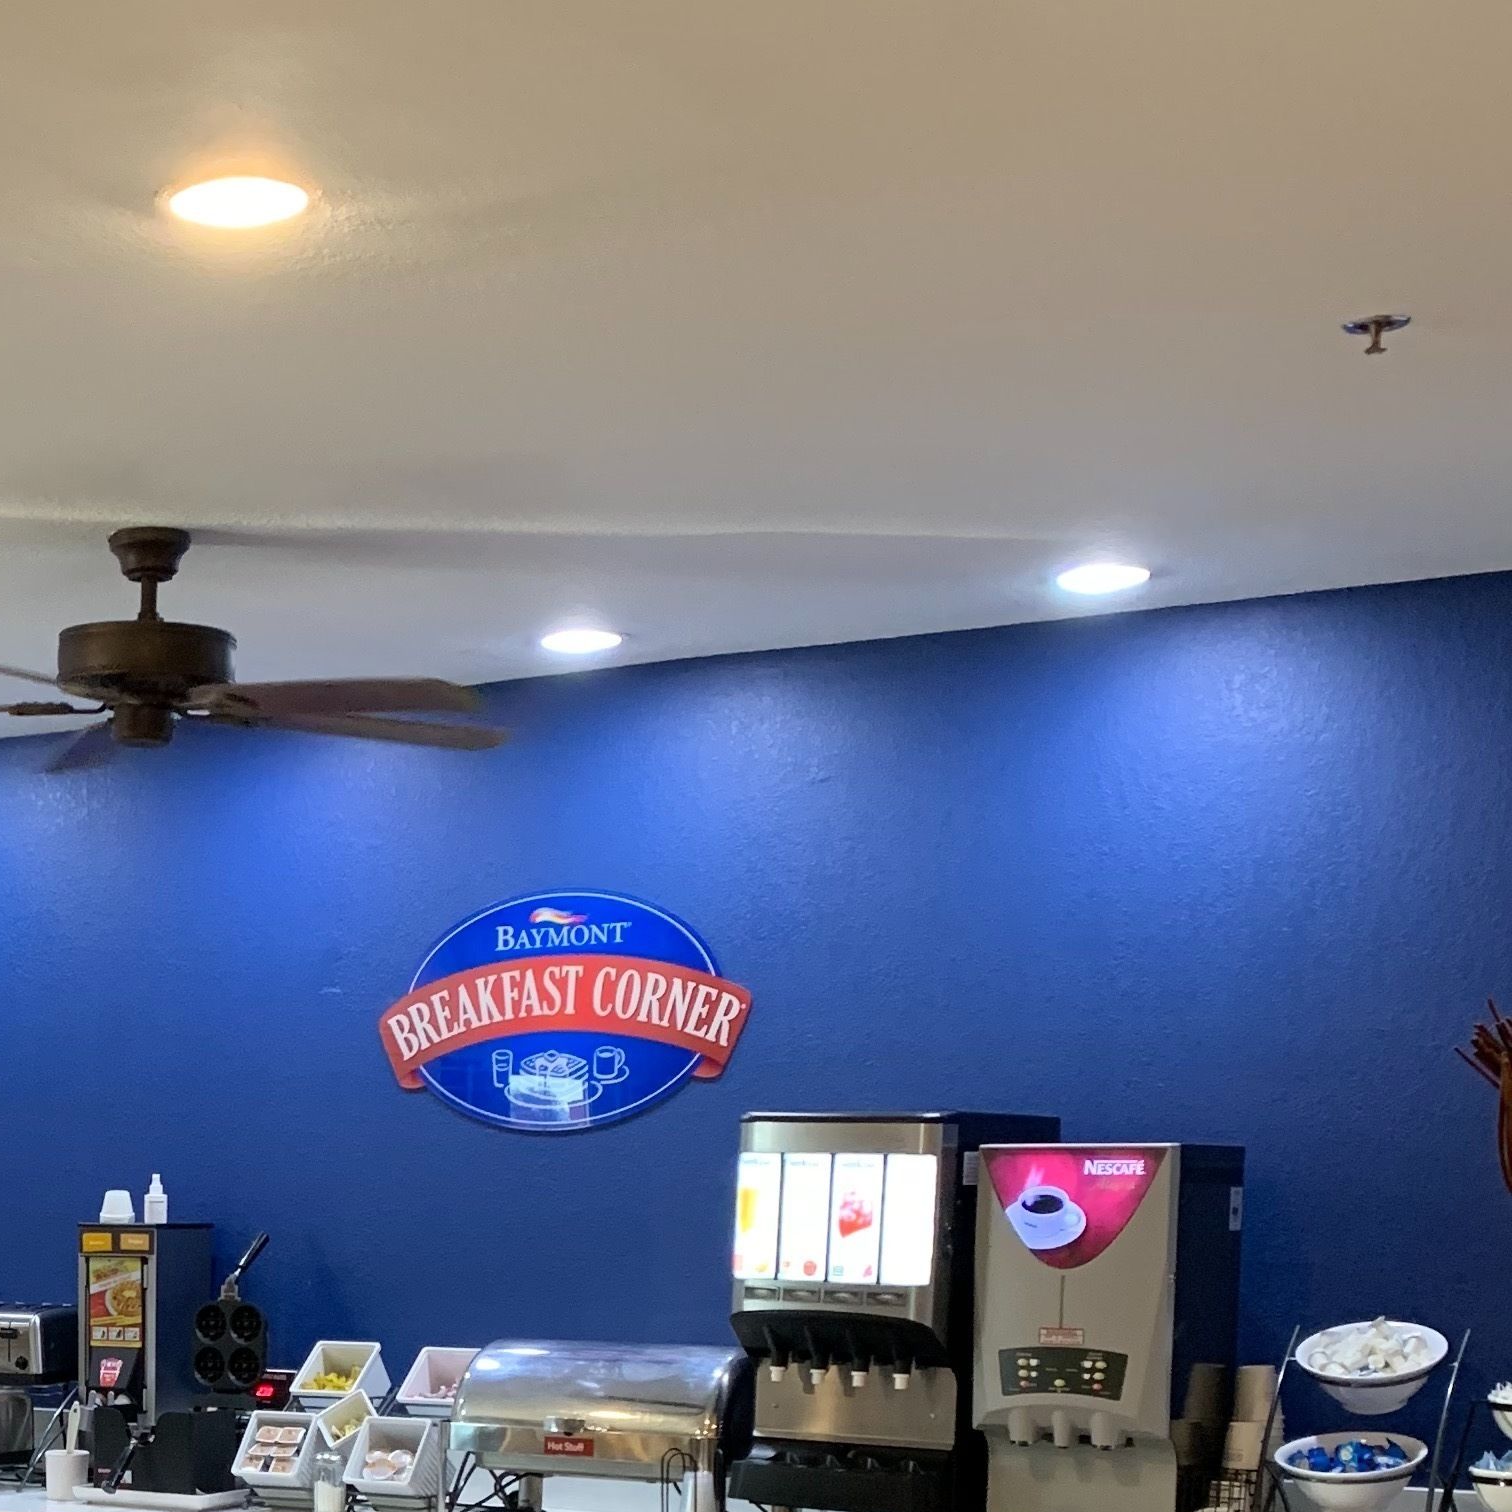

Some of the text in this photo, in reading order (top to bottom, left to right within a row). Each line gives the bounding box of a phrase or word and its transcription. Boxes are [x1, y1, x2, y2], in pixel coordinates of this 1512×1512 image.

[494, 922, 627, 951] BAYMONT
[387, 965, 741, 1061] BREAKFAST CORNER
[1083, 1159, 1146, 1176] NESCAFÉ
